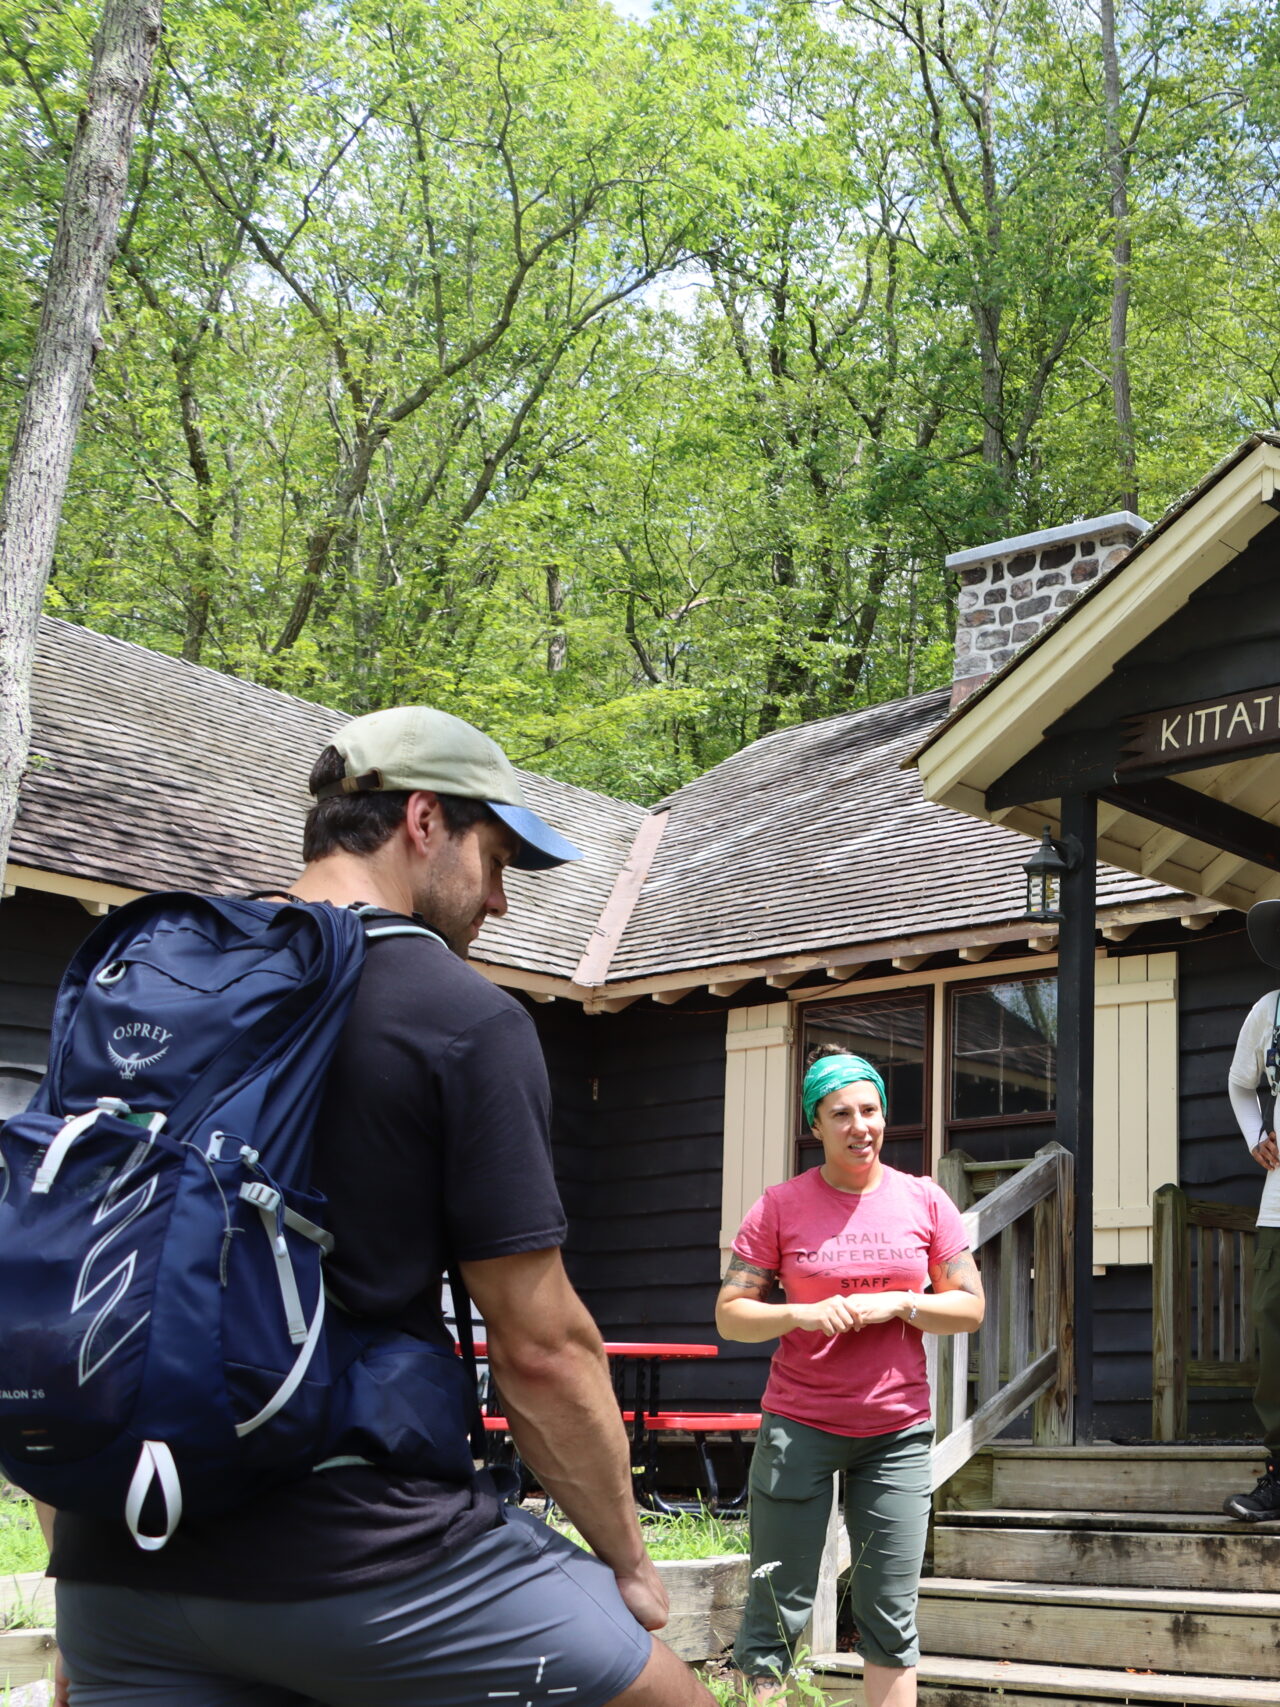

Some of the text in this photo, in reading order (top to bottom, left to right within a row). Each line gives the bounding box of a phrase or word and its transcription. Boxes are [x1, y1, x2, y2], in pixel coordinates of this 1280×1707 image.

[113, 1022, 173, 1044] OSPREY
[832, 1232, 891, 1247] TRAIL
[796, 1246, 923, 1264] CONFERENCE
[840, 1277, 891, 1289] STAFF
[0, 1388, 46, 1399] ALON 26
